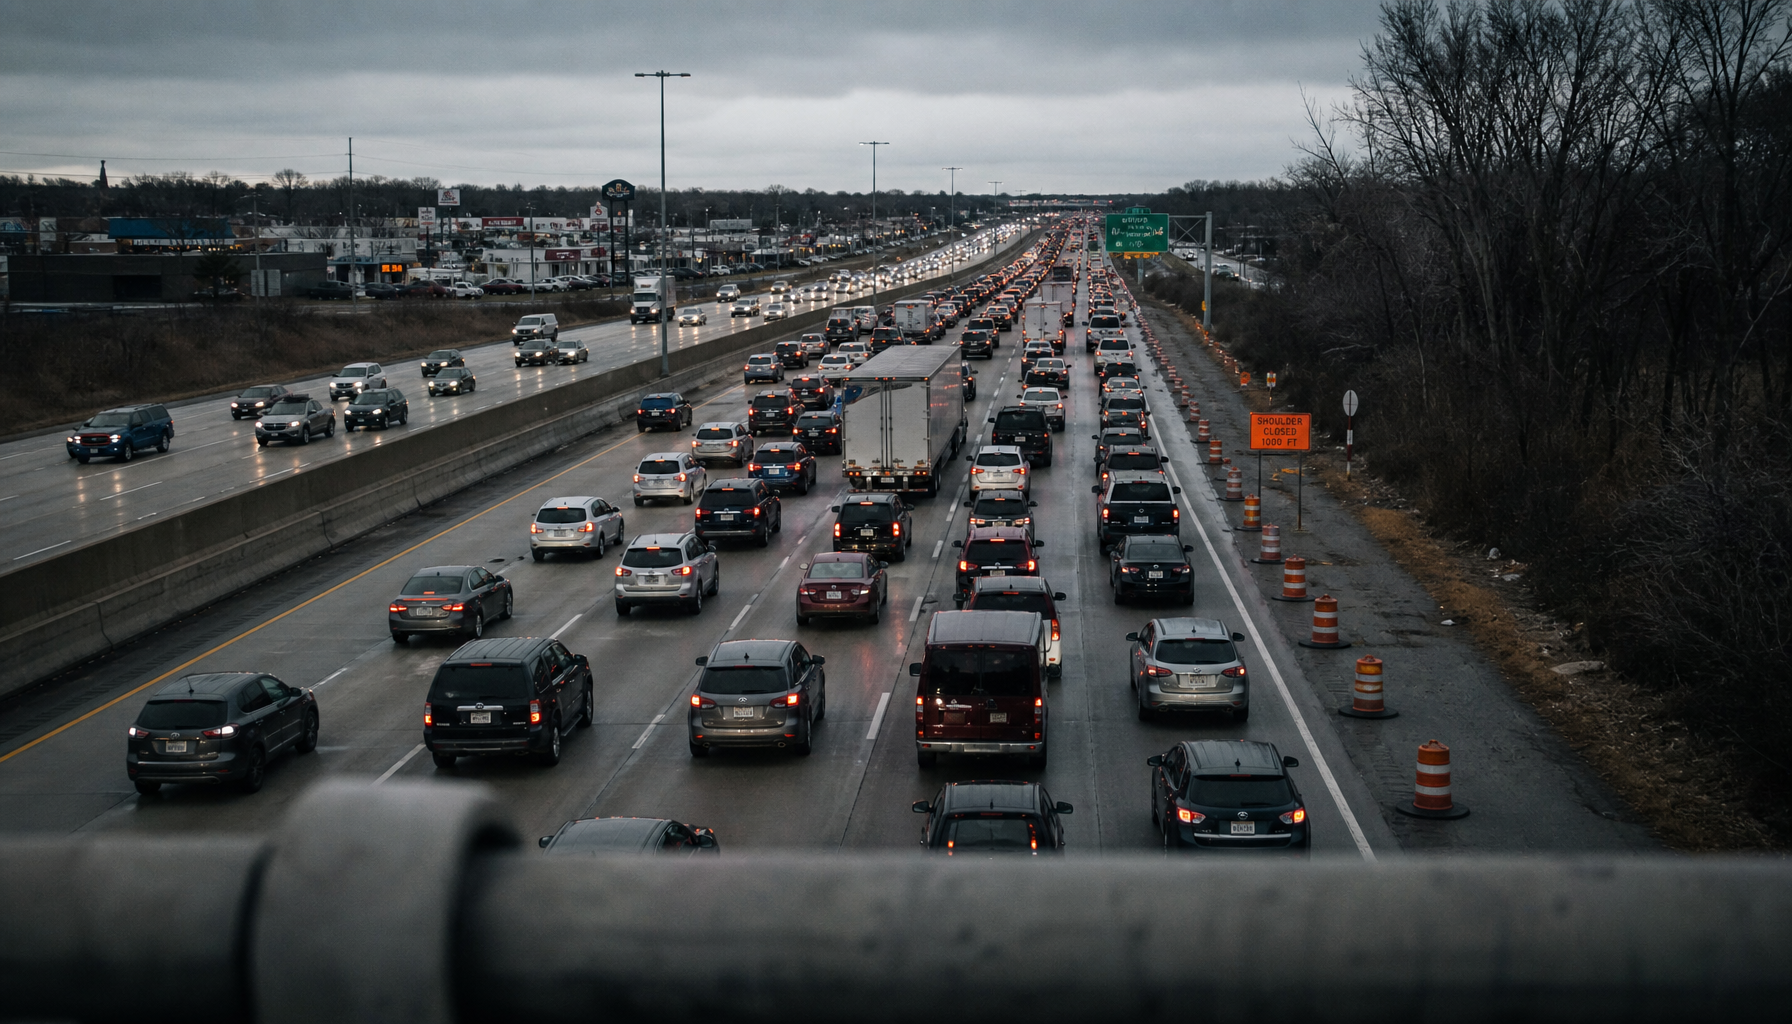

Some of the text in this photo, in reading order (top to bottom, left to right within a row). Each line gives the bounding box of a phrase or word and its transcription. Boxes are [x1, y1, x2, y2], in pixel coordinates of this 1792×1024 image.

[1257, 417, 1303, 426] SHOULDER
[1263, 427, 1297, 435] CLOSED
[1262, 438, 1297, 446] 1000 FT
